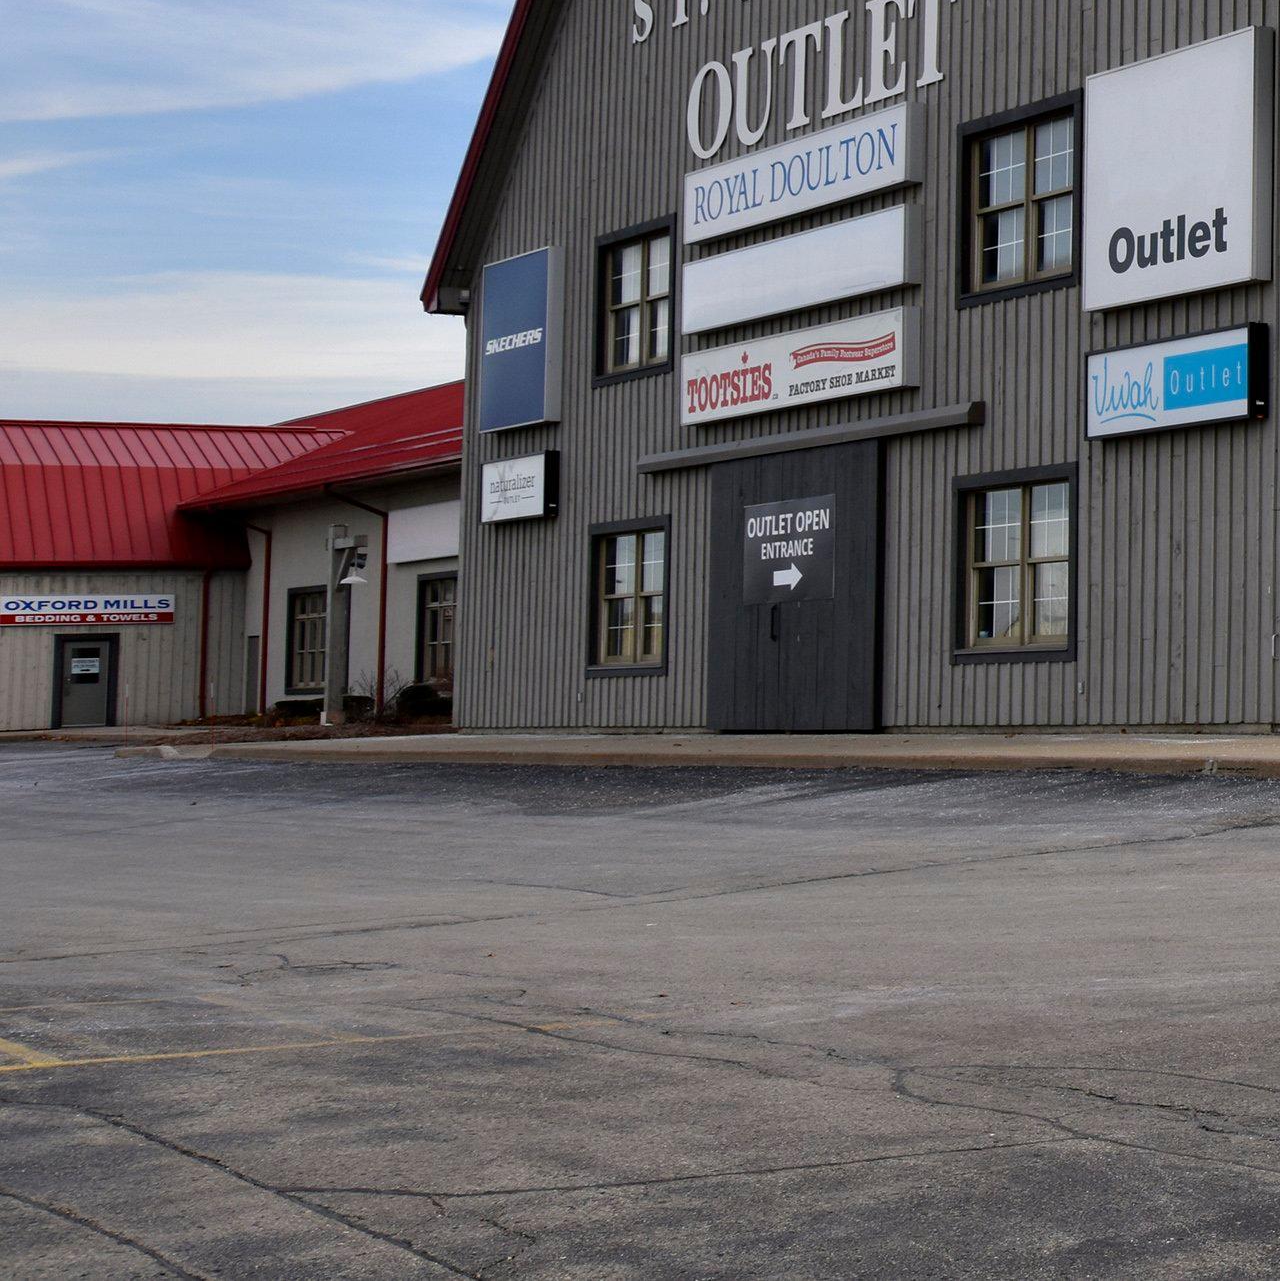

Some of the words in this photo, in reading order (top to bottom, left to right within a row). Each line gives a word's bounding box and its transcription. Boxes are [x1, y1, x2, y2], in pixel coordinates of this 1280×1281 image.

[693, 168, 764, 225] ROYAL
[770, 123, 898, 203] DOULTON
[1108, 207, 1228, 274] Outlet
[485, 327, 543, 356] SKECHERS
[821, 349, 840, 358] Family
[840, 349, 864, 358] Footwear
[864, 342, 894, 357] Superstore
[688, 362, 772, 414] TOOTSIES
[789, 378, 828, 397] FACTORY
[829, 374, 853, 389] SHOE
[855, 365, 896, 384] MARKET
[1170, 361, 1242, 395] Outlet
[490, 473, 536, 494] naturalizer
[747, 513, 793, 538] OUTLET
[795, 508, 830, 533] OPEN
[761, 538, 814, 560] ENTRANCE
[4, 600, 98, 612] OXFORD
[104, 599, 171, 610] MILLS
[15, 614, 81, 623] BEDDING
[86, 614, 96, 622] &
[101, 613, 158, 622] TOWELS
